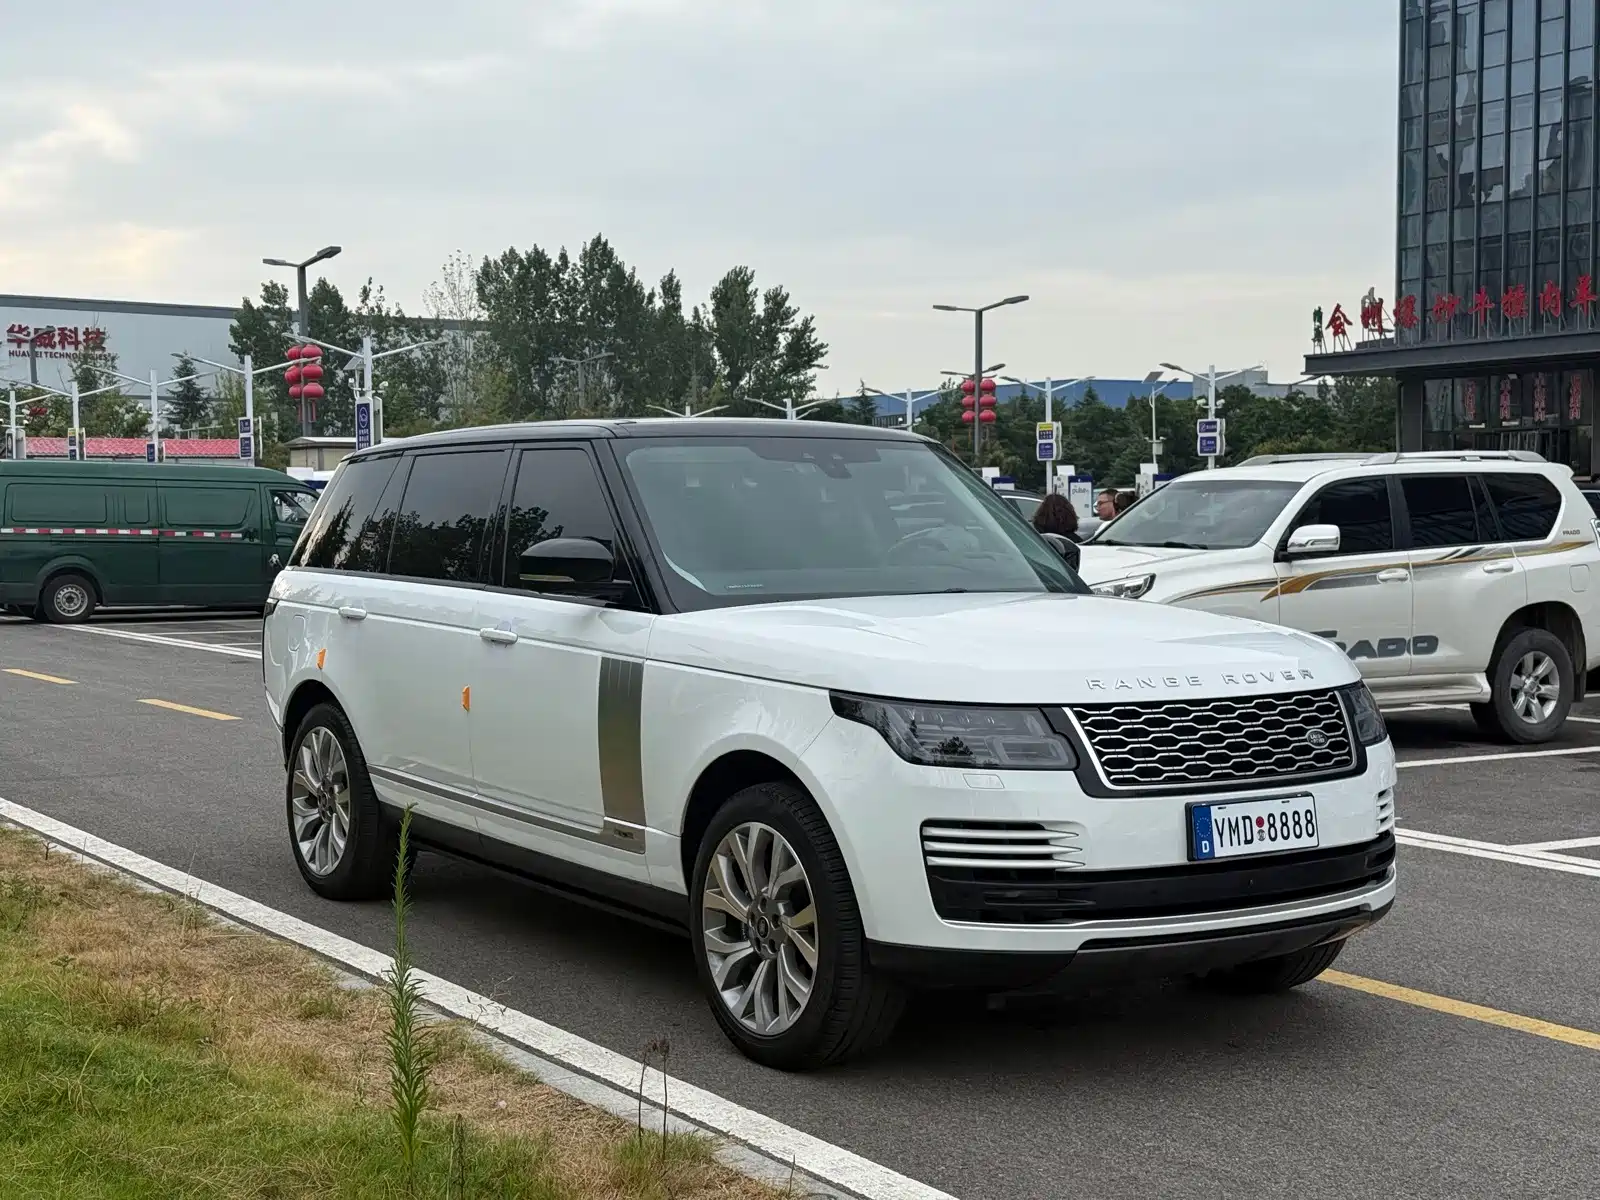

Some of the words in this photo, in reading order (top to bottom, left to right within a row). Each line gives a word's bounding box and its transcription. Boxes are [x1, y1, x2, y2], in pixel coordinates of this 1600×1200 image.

[1085, 674, 1204, 690] RANGE
[1221, 668, 1315, 685] ROVER
[1214, 815, 1254, 848] YMD
[1267, 809, 1315, 842] 8888
[1201, 840, 1210, 853] D
